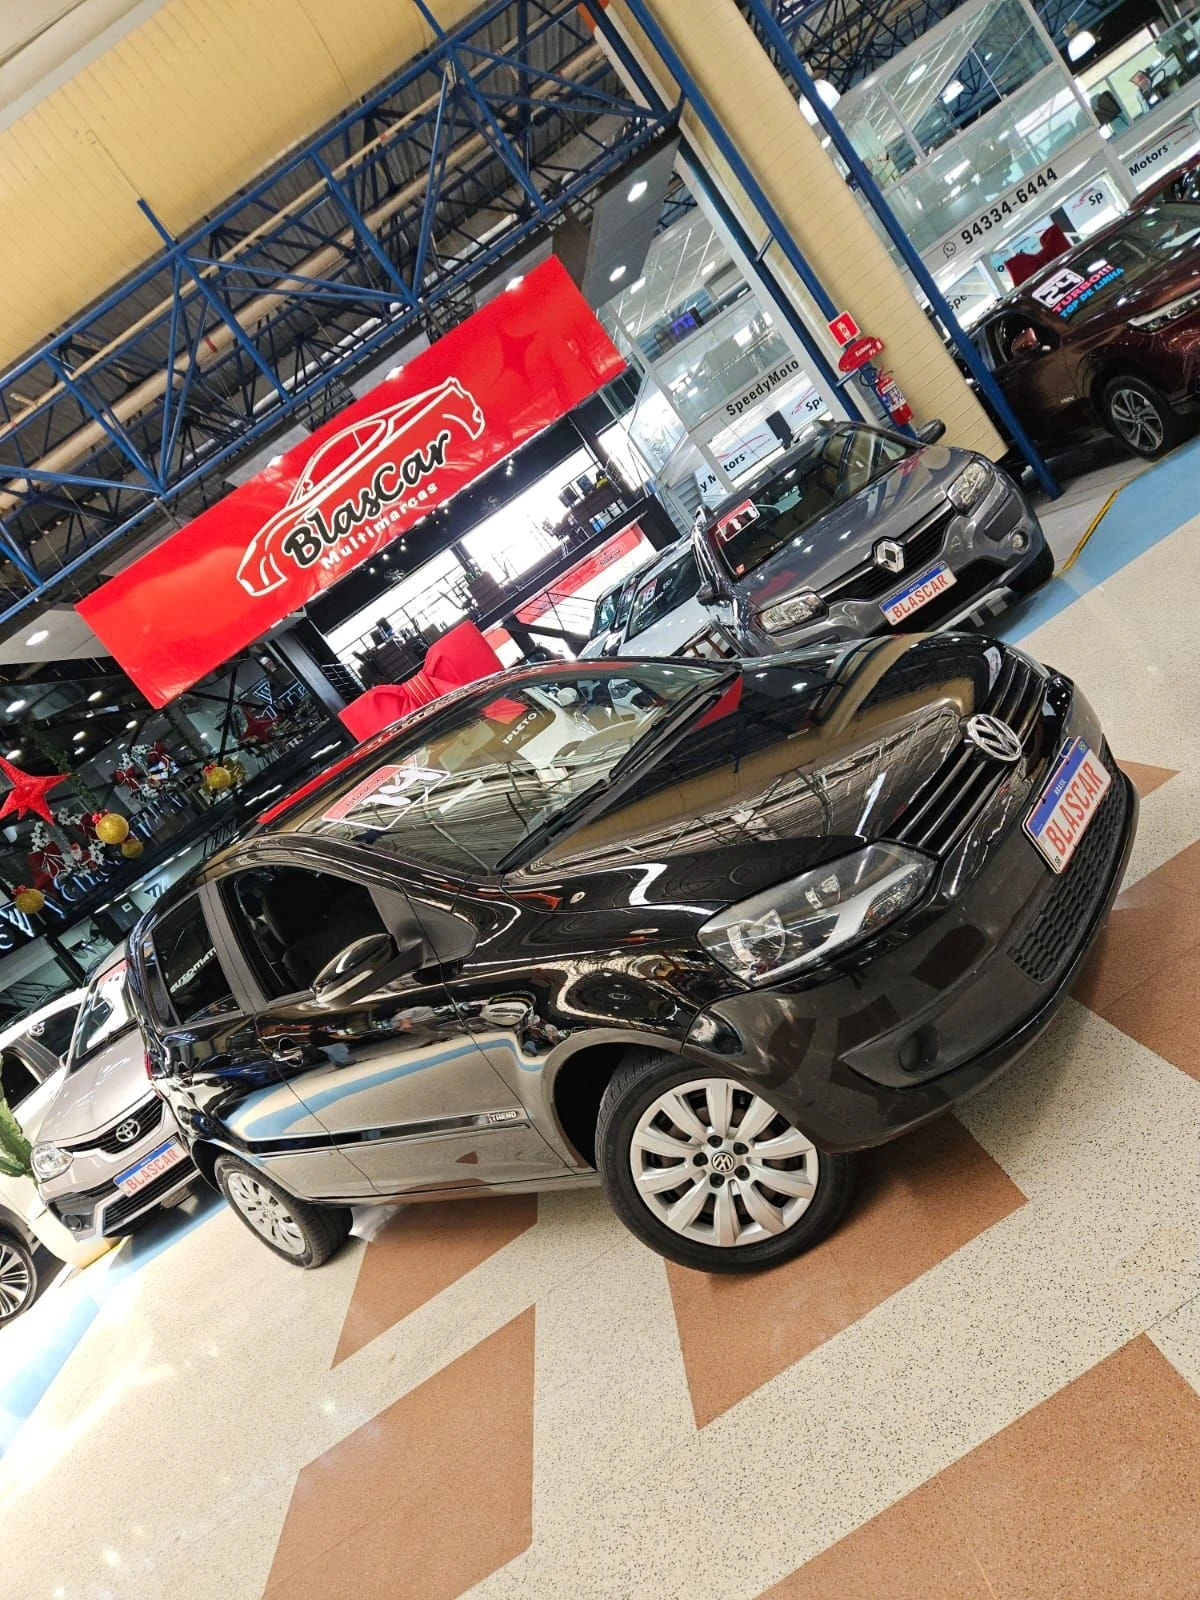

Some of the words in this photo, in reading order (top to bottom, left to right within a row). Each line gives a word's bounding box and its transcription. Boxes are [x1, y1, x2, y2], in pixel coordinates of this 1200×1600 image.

[1128, 144, 1169, 176] Motors
[961, 167, 1058, 245] 94334-6444
[1060, 299, 1079, 318] TOP
[1079, 288, 1095, 302] DE
[1094, 267, 1125, 290] LINHA
[282, 431, 451, 567] BlasCar
[320, 482, 438, 570] Multimarcas
[891, 574, 949, 619] BLASCAR
[1045, 760, 1104, 856] BLASCAR
[126, 1148, 180, 1191] BLASCAR
